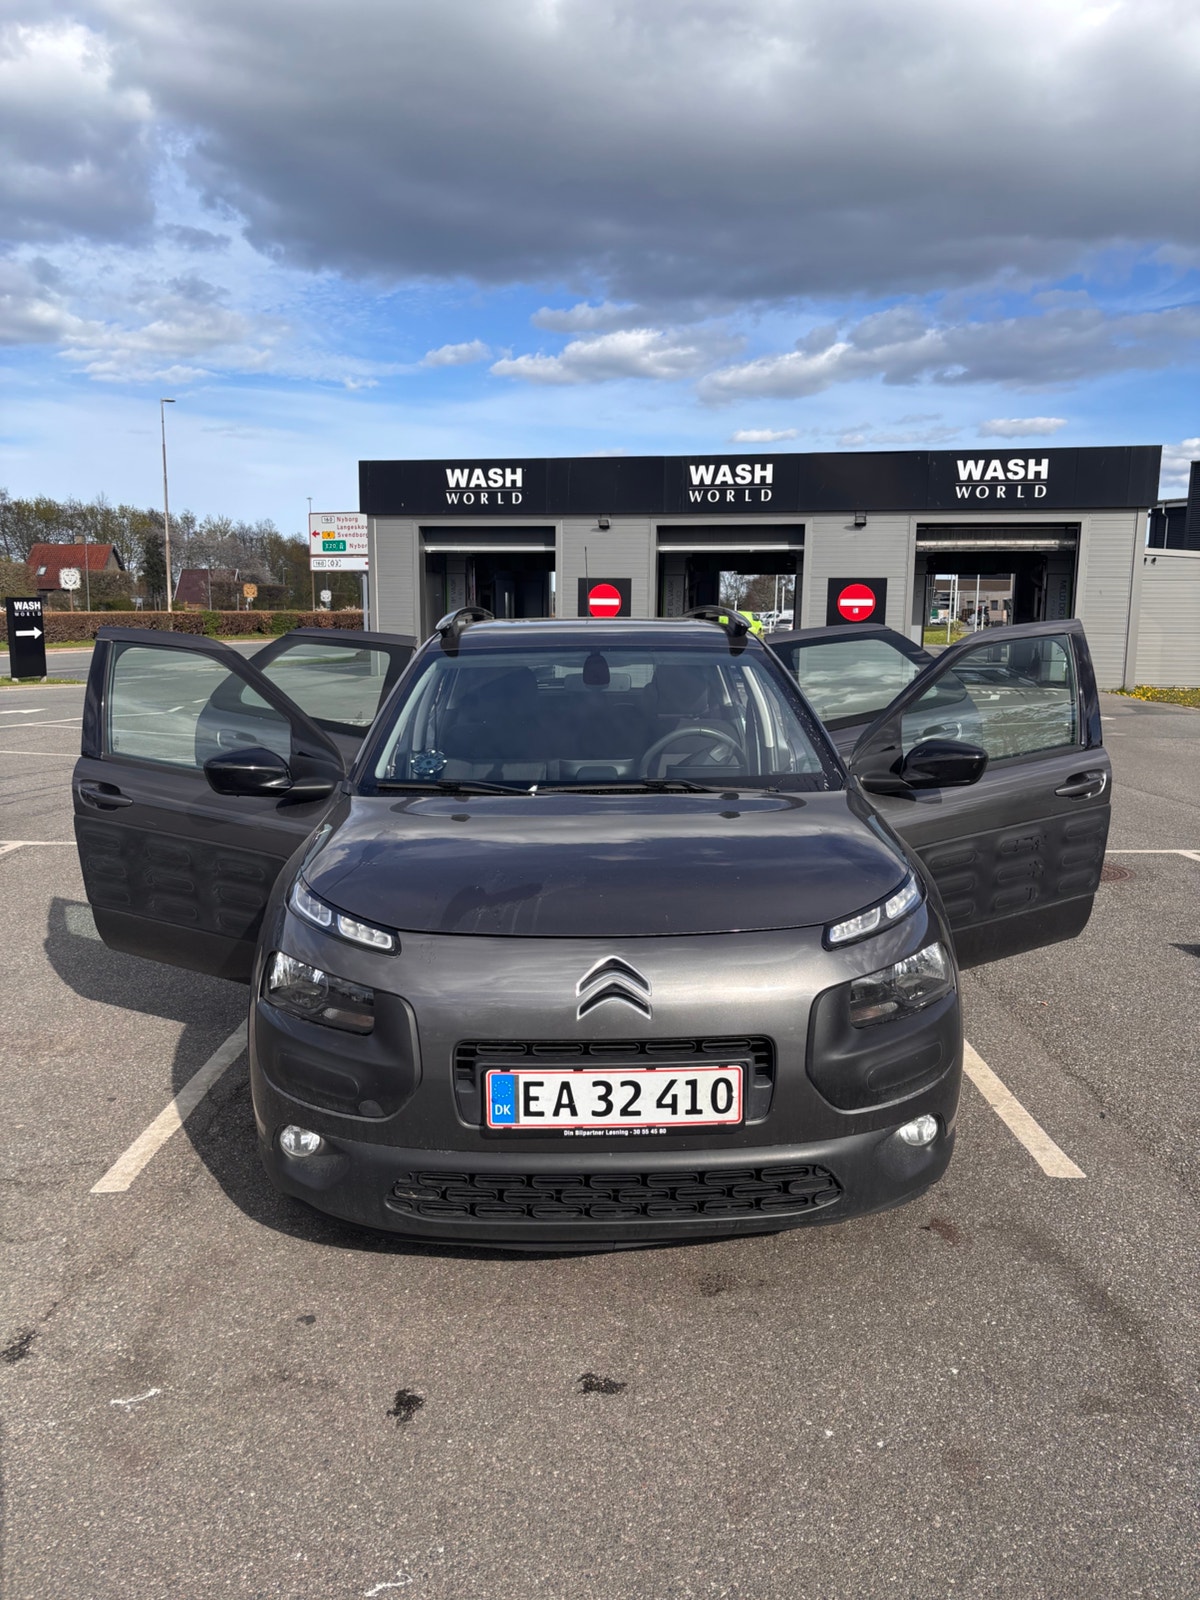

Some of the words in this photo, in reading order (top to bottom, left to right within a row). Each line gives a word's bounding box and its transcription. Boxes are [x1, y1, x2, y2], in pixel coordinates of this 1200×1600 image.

[689, 463, 774, 485] WASH
[957, 458, 1049, 481] WASH
[445, 467, 523, 488] WASH
[446, 492, 523, 505] WORLD
[688, 489, 773, 503] WORLD
[955, 485, 1048, 499] WORLD
[13, 601, 41, 611] WASH
[522, 1080, 579, 1118] EA
[591, 1080, 642, 1117] 32
[655, 1077, 735, 1117] 410
[494, 1104, 512, 1116] DK
[575, 1129, 604, 1137] Bilpartner
